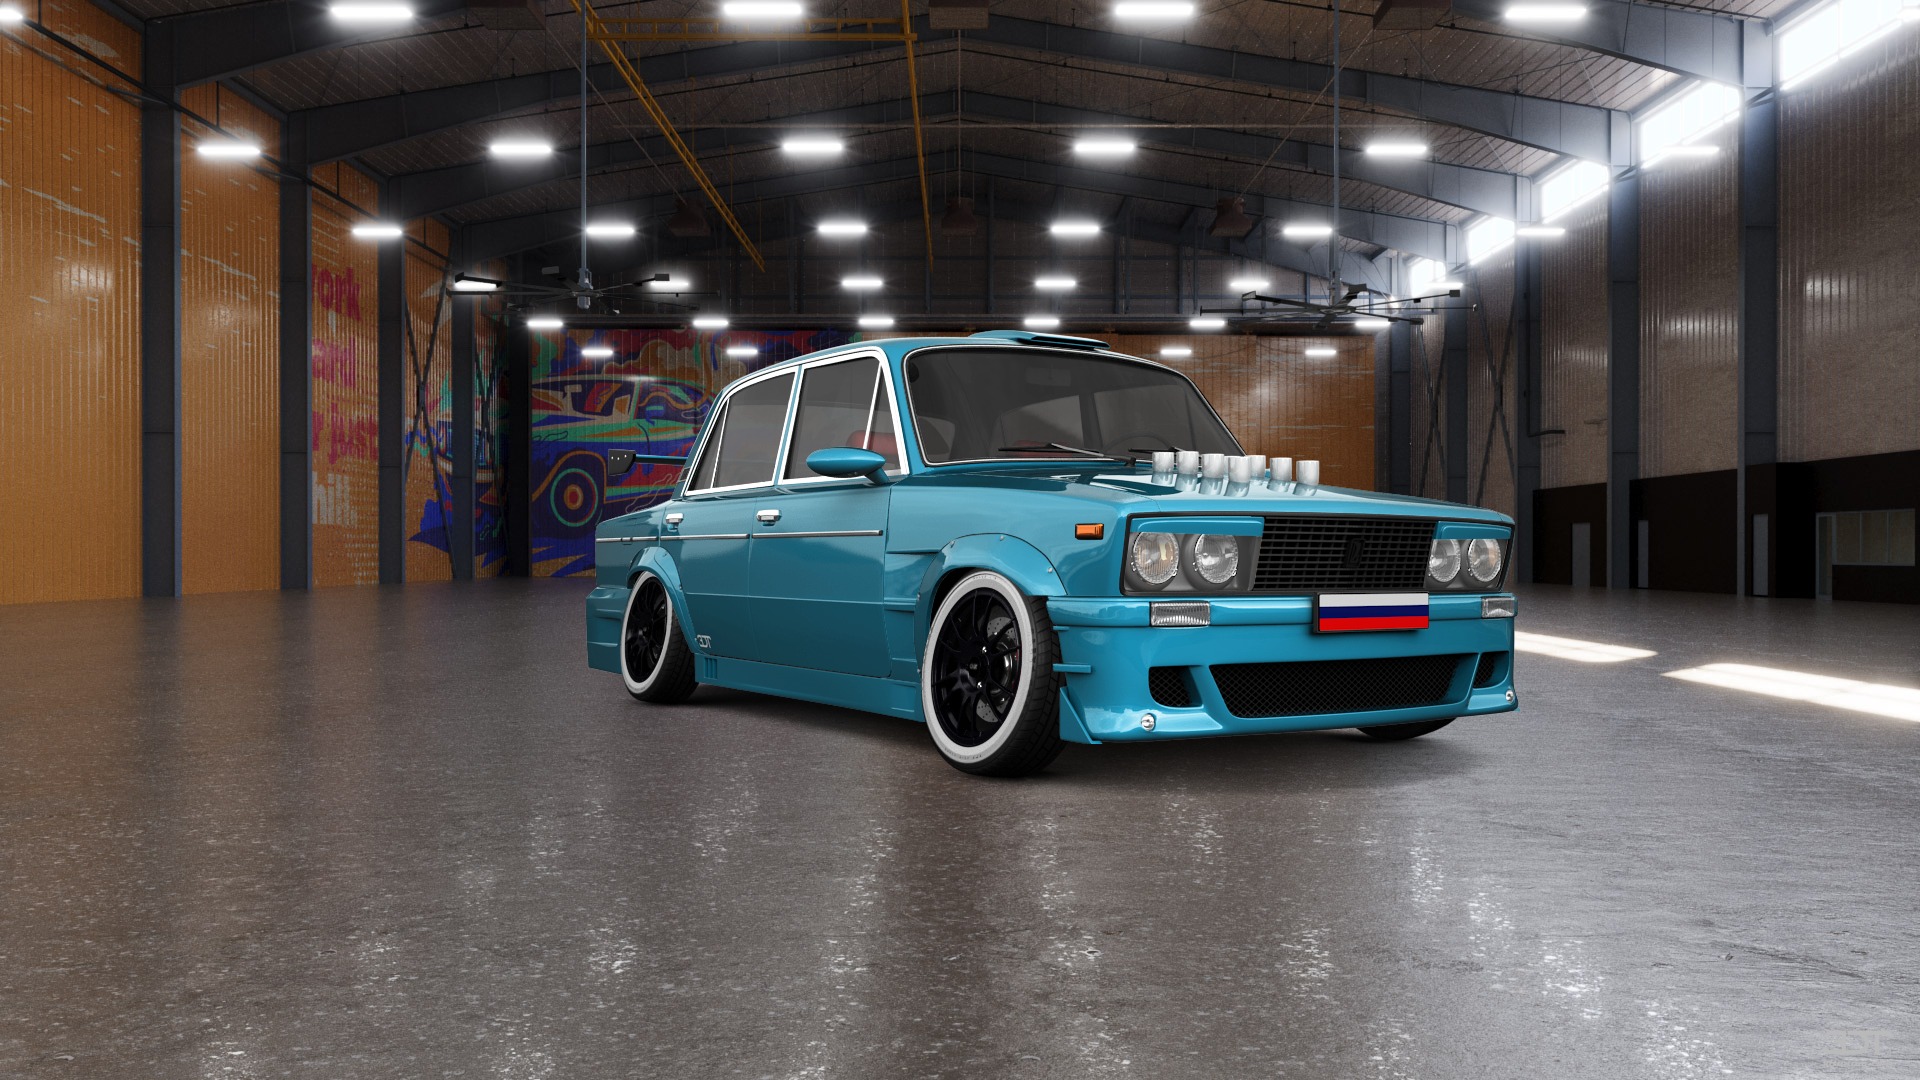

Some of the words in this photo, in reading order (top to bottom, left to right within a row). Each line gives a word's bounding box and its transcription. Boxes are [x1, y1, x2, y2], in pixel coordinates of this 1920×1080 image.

[312, 264, 361, 321] ork
[312, 337, 355, 390] ard
[329, 402, 378, 465] just
[312, 471, 357, 527] hill.
